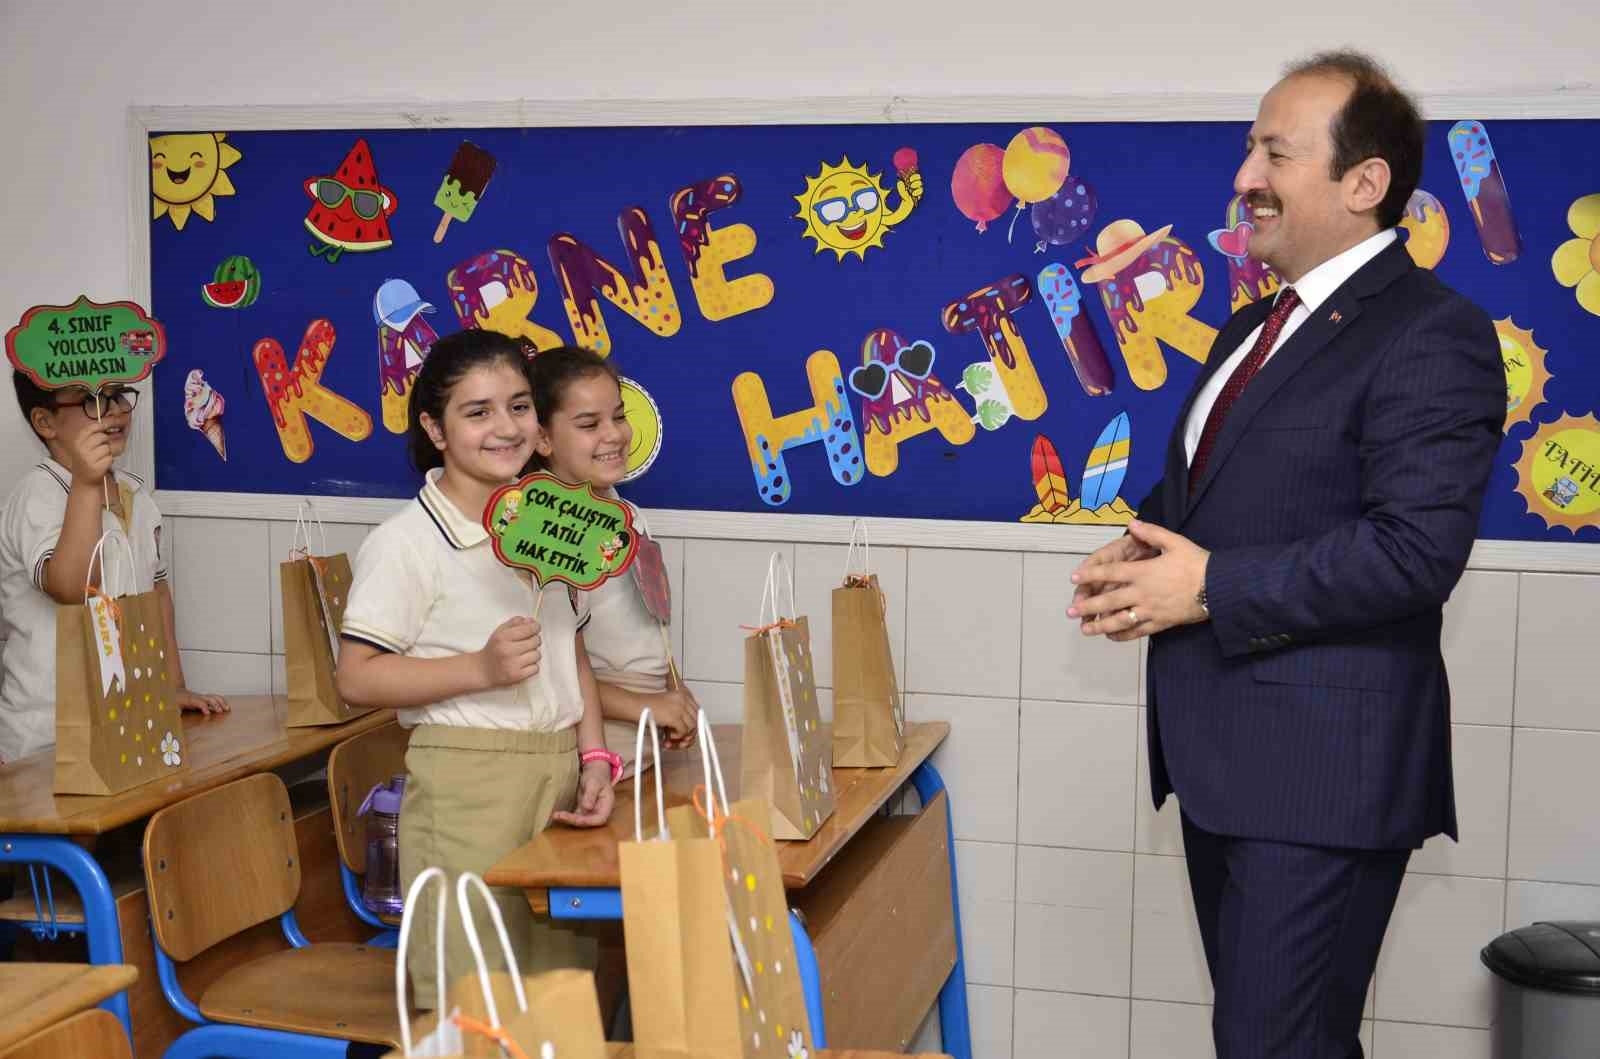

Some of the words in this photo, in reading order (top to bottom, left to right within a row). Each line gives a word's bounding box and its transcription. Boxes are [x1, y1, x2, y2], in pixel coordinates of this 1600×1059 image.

[48, 317, 65, 335] 4.
[68, 315, 113, 334] SINIF
[252, 172, 775, 463] KARNE
[48, 336, 116, 356] YOLCUSU
[45, 357, 127, 378] KALMASIN
[525, 488, 556, 511] ÇOK
[558, 500, 621, 532] ÇALIŞTIK
[540, 520, 587, 546] TATİLİ
[514, 539, 549, 562] HAK
[549, 552, 589, 575] ETTİK
